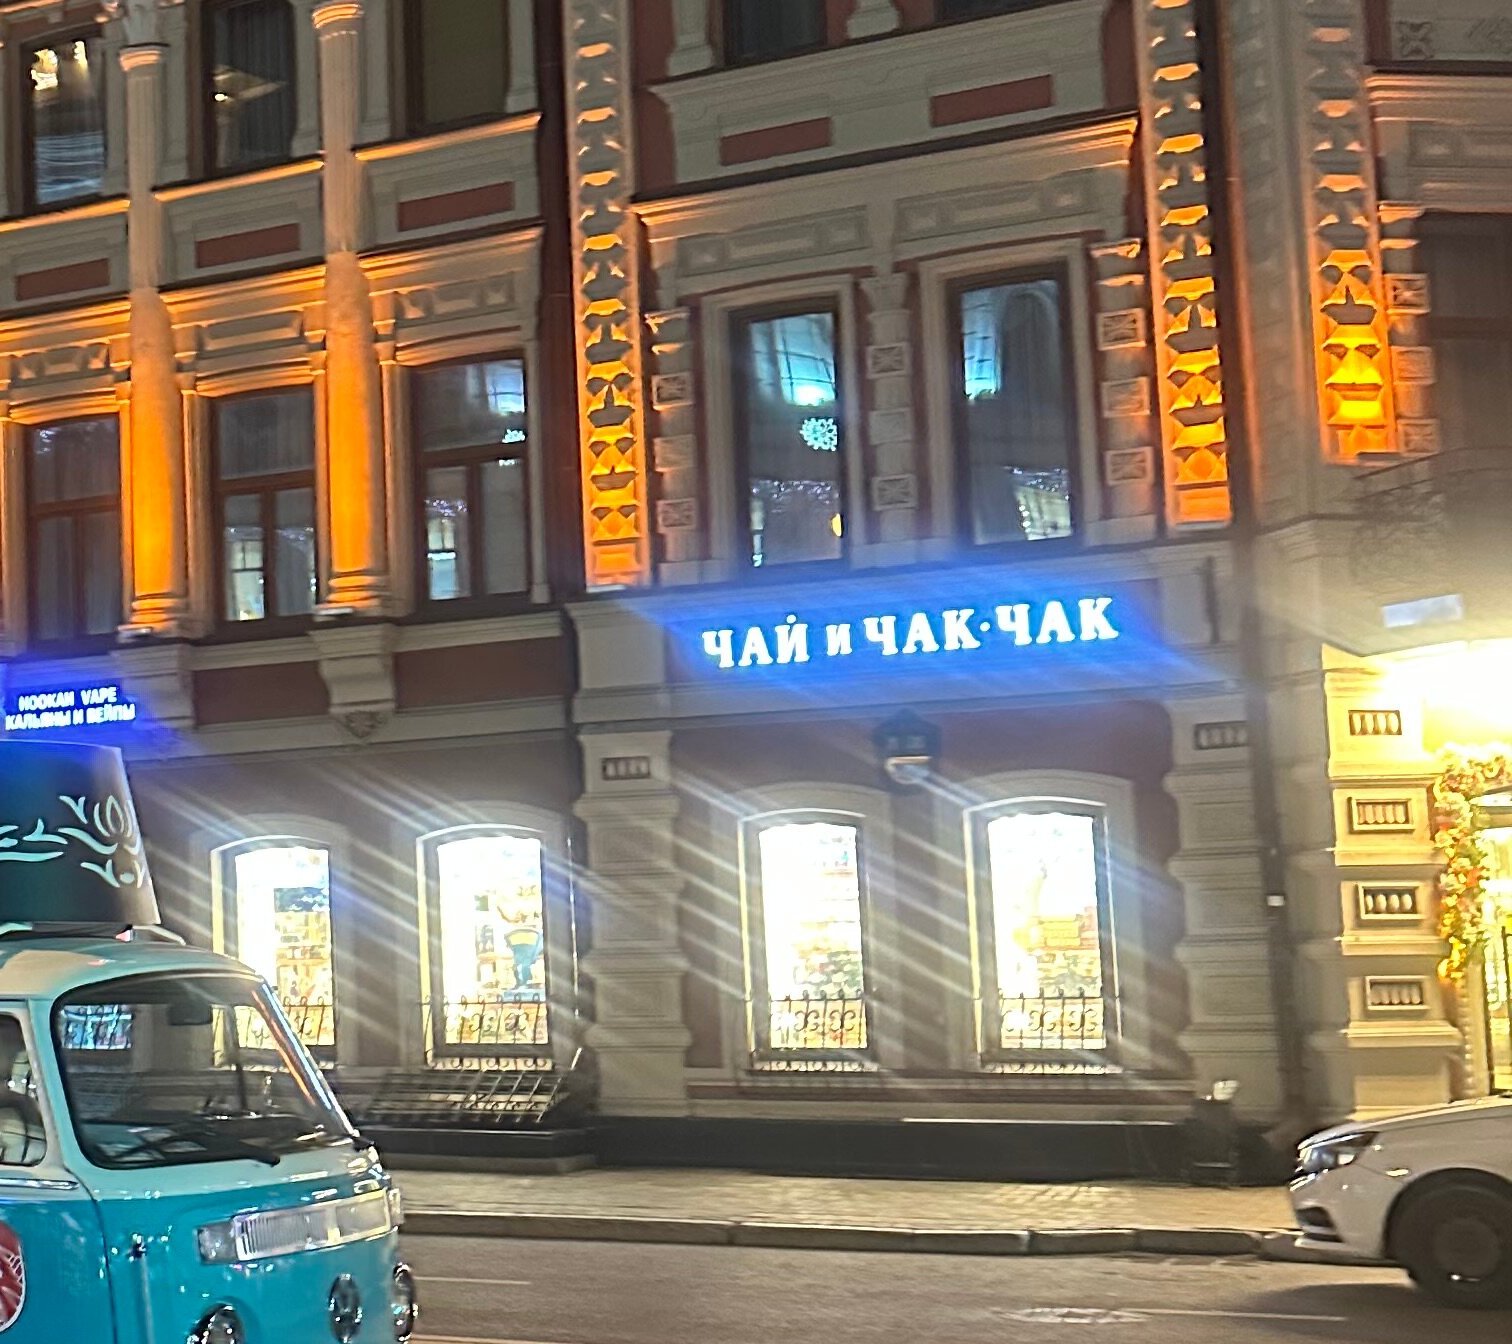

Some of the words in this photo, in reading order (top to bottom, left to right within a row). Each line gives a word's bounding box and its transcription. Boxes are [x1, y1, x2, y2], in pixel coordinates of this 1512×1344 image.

[701, 614, 810, 669] ЧАЙ
[80, 686, 117, 705] VAPE
[5, 709, 72, 731] КАЛЬЯНЫ
[86, 703, 136, 724] ВЕЙПЫ
